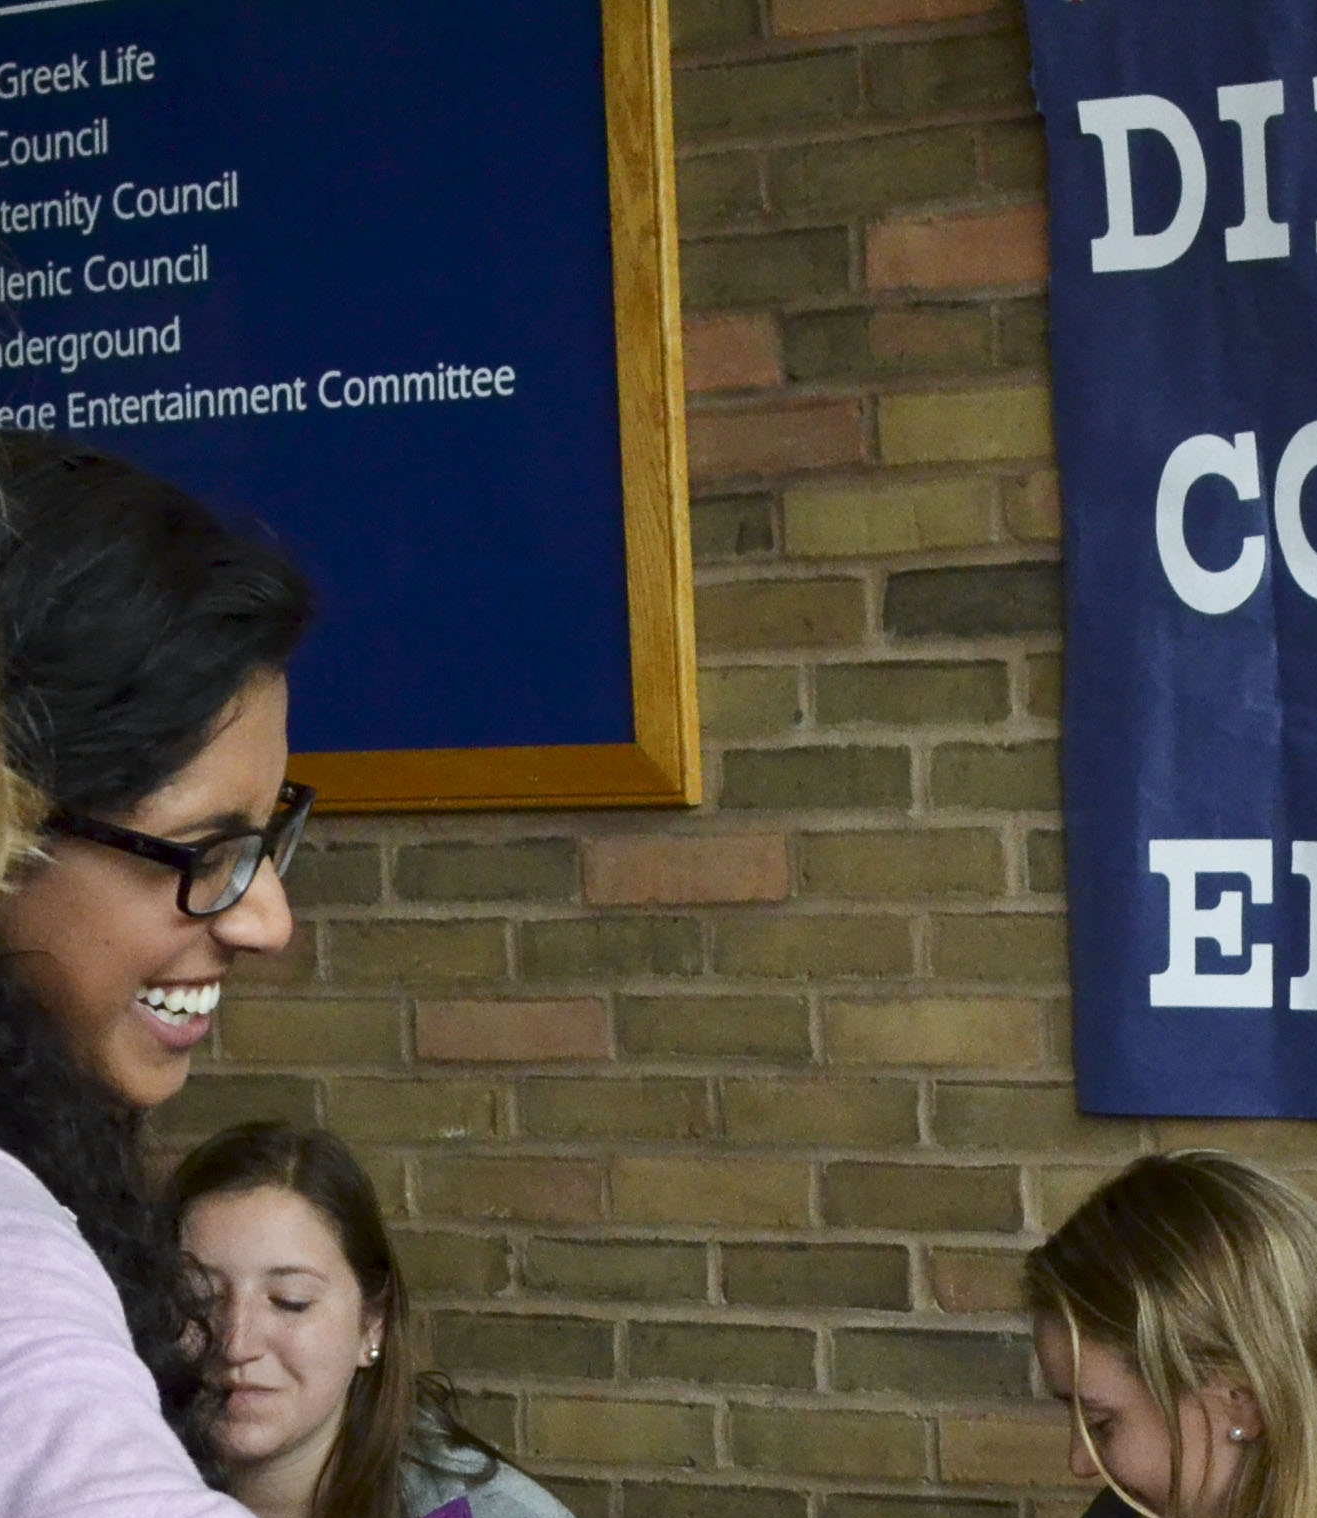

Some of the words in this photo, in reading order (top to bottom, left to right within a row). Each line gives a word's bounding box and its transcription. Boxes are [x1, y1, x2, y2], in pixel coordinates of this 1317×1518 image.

[100, 46, 156, 87] Life
[112, 171, 238, 221] Council
[84, 244, 208, 293] Council
[67, 377, 307, 429] Entertainment
[318, 362, 516, 409] Committee
